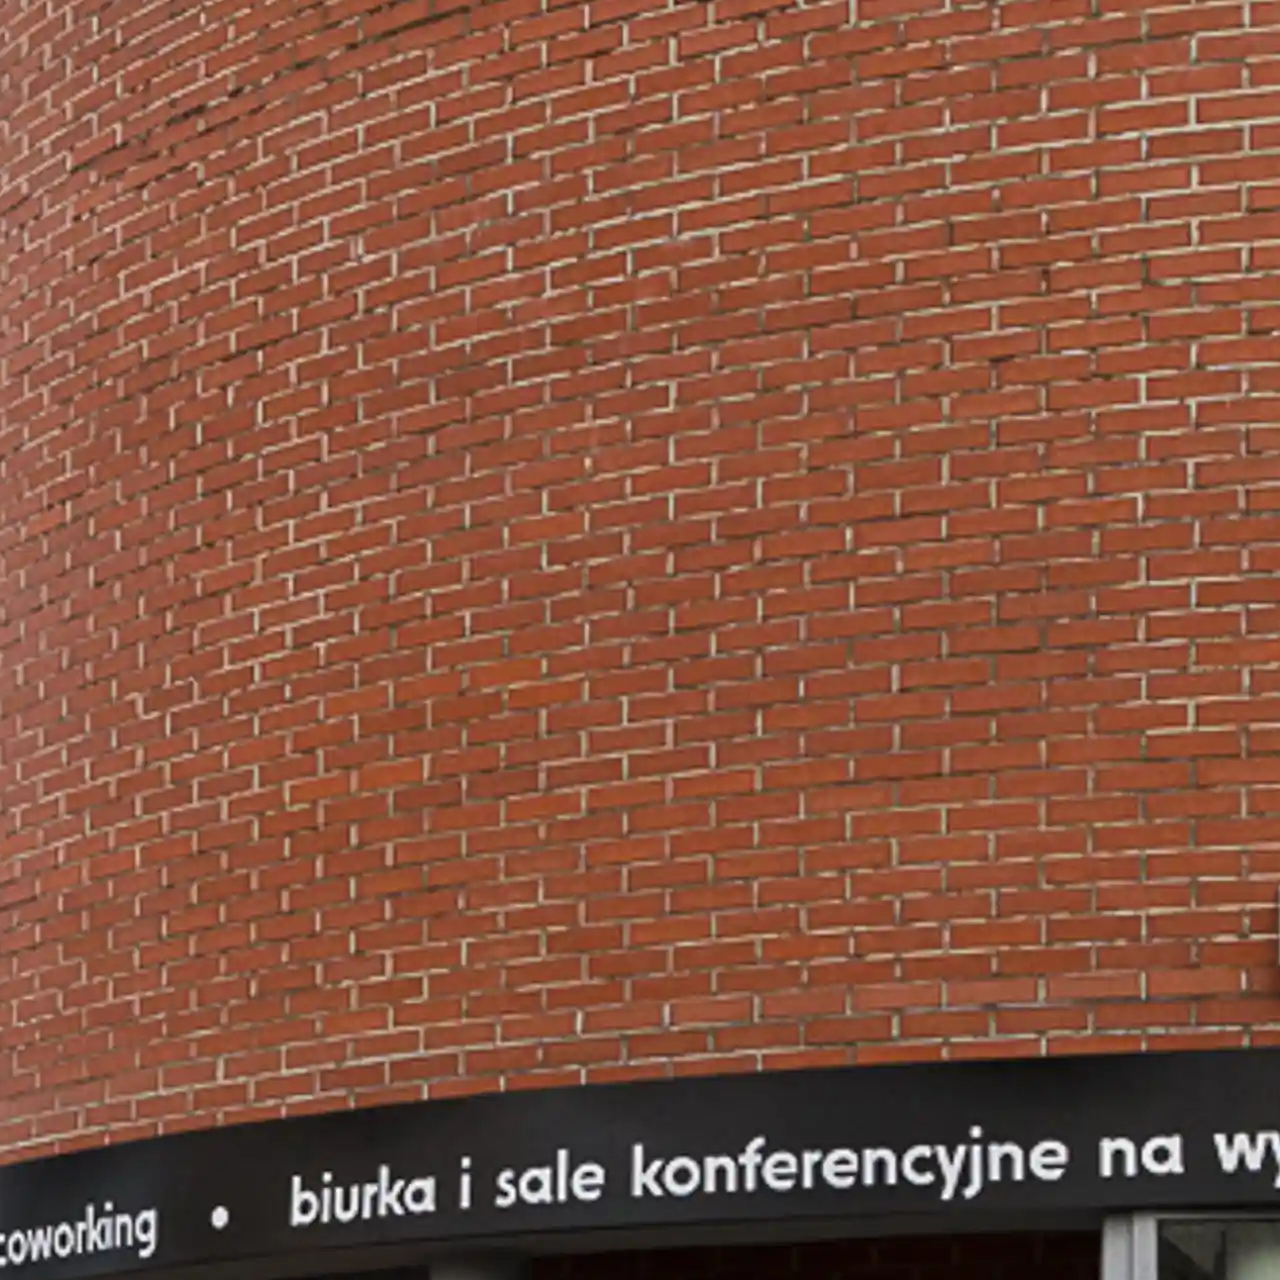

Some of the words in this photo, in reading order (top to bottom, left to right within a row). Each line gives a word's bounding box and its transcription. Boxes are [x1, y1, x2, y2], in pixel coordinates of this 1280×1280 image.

[290, 1164, 437, 1227] biurka
[459, 1156, 472, 1210] i
[494, 1148, 606, 1209] sale
[630, 1125, 1070, 1201] konferencyjne
[1099, 1132, 1184, 1177] na
